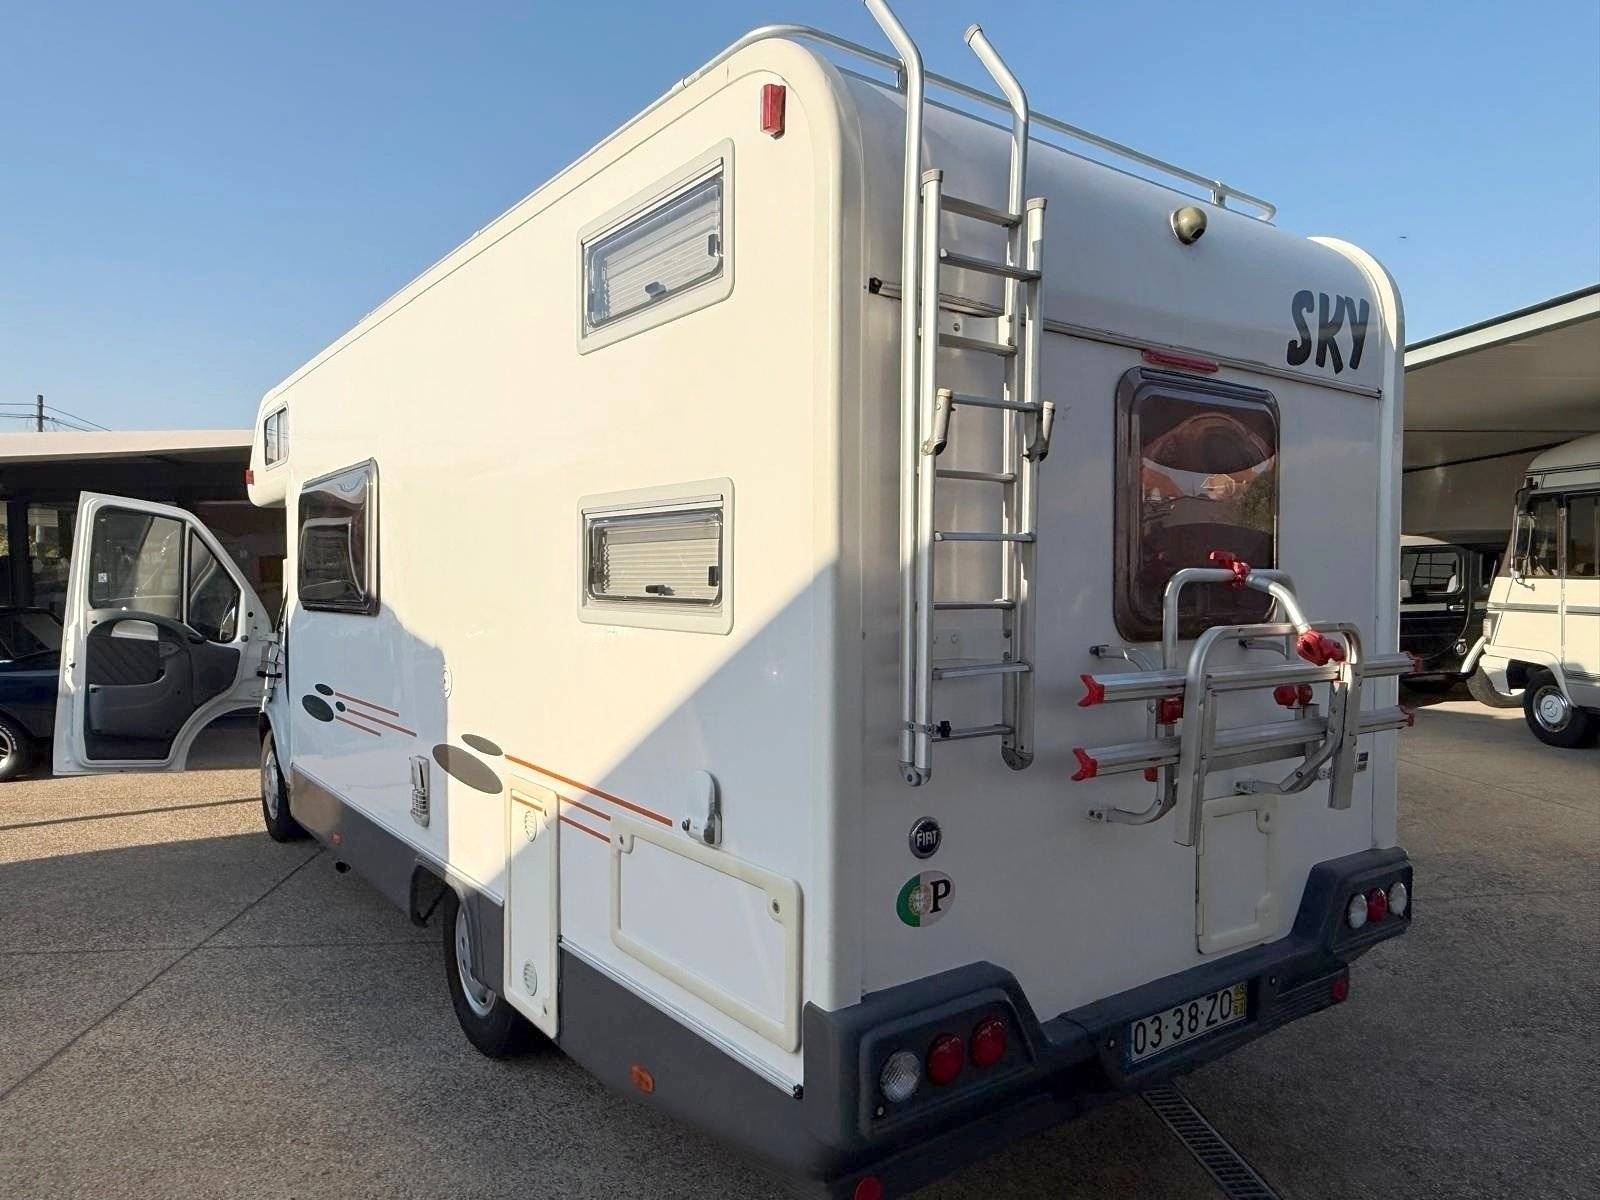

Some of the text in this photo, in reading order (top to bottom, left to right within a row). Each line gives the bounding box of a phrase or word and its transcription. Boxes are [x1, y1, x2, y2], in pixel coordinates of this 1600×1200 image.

[1287, 290, 1370, 375] SKY
[916, 830, 937, 847] FIAT
[929, 878, 951, 914] P
